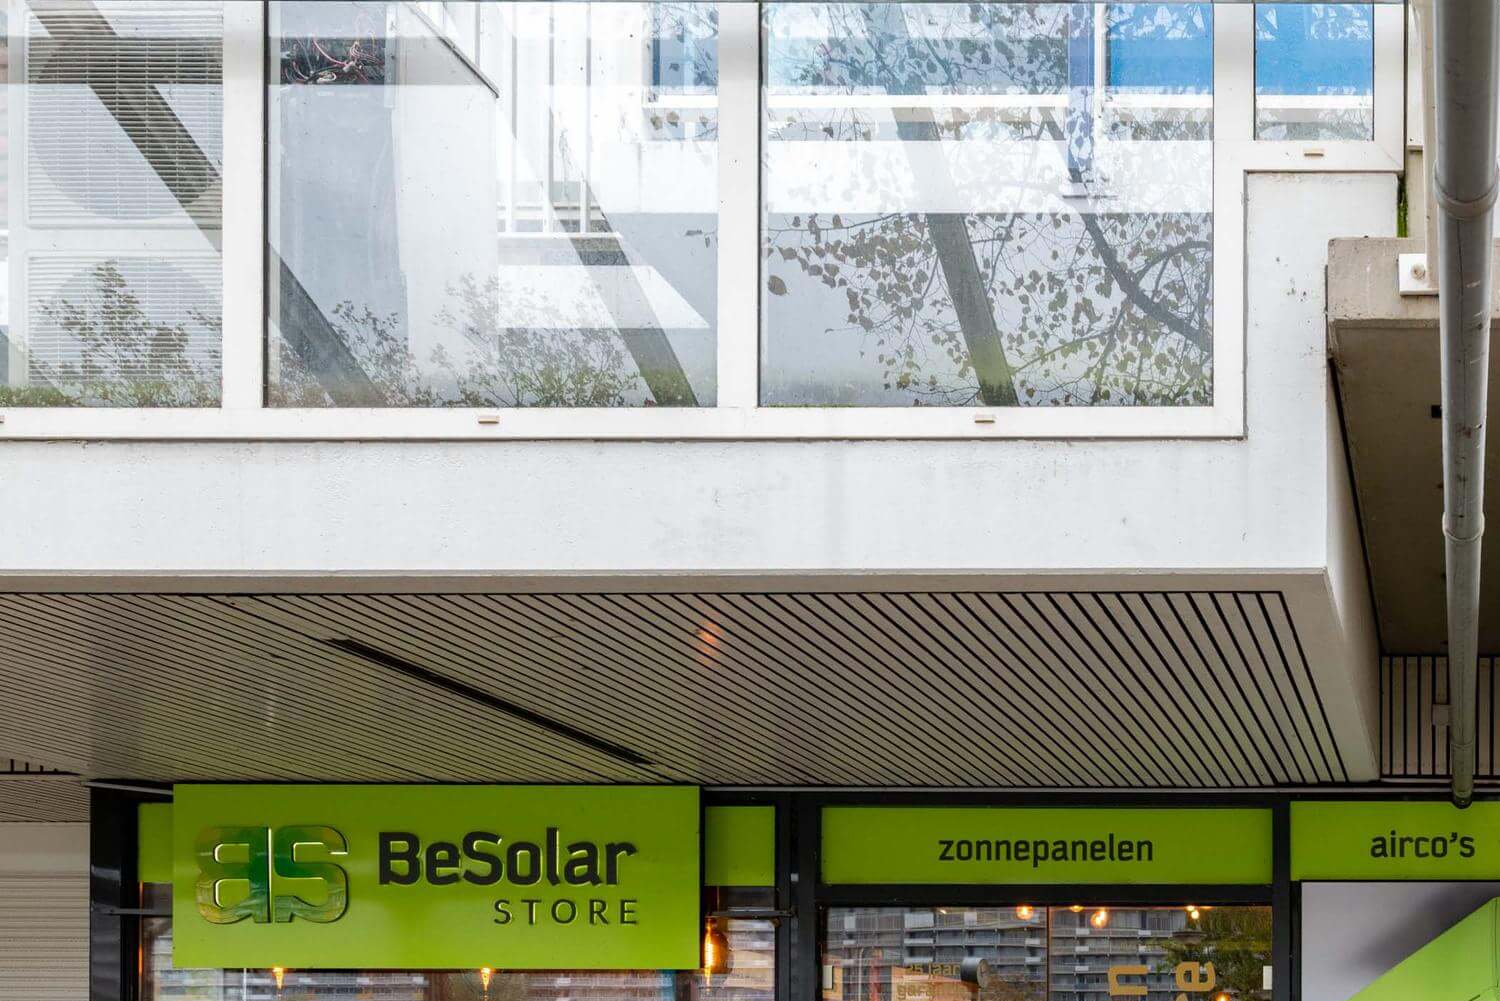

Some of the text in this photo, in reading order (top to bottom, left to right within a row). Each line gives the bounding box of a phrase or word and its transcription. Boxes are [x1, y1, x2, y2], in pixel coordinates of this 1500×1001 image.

[378, 826, 638, 887] BeSolar
[937, 832, 1154, 868] zonnepanelen
[1370, 829, 1476, 859] airco's
[493, 898, 639, 926] STORE
